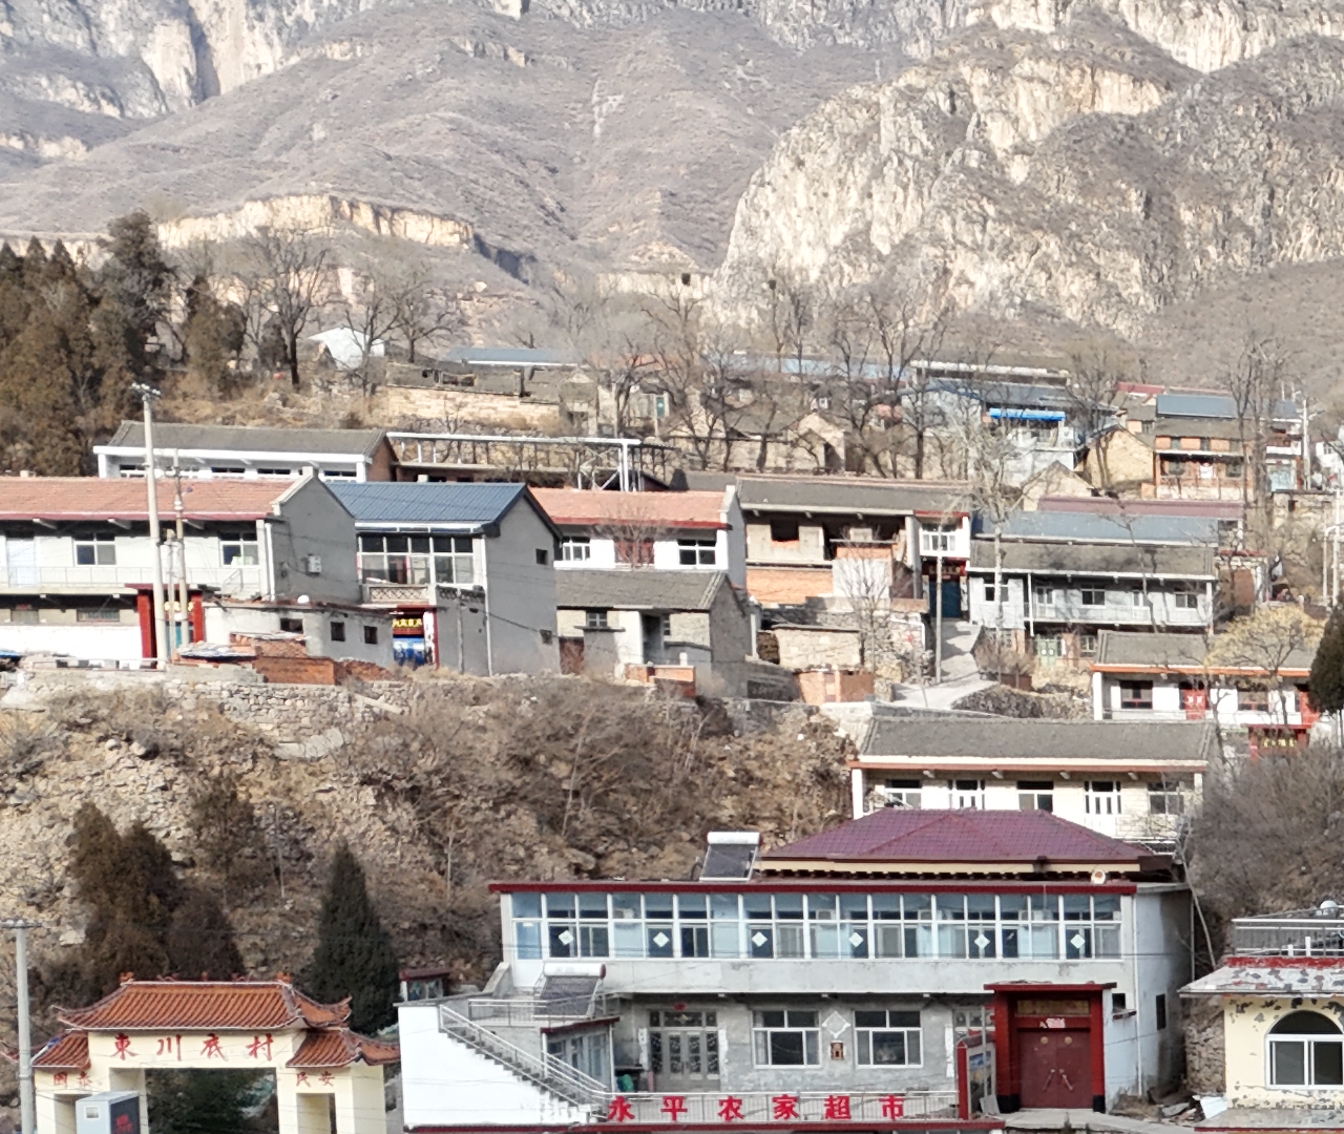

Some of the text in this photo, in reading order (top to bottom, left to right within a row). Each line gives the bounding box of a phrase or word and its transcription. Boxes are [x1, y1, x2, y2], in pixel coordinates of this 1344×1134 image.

[111, 1032, 274, 1062] 東川底村
[296, 1071, 336, 1087] 民安
[607, 1094, 906, 1122] 永平农家超市
